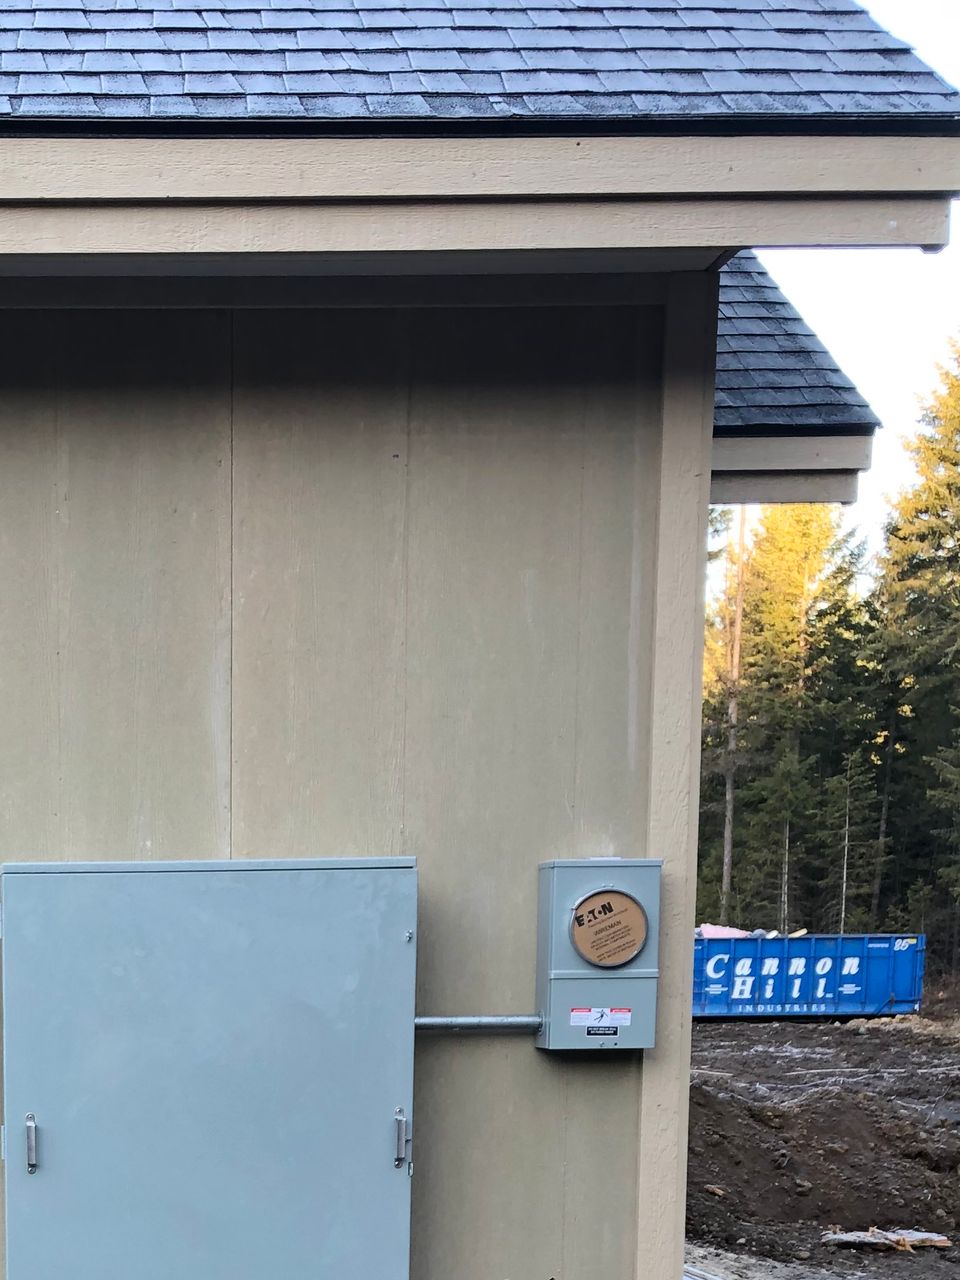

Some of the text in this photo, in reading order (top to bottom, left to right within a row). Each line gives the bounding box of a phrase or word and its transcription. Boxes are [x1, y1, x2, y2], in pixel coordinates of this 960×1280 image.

[706, 953, 860, 979] Cannon
[731, 976, 827, 999] Hill
[739, 1003, 826, 1013] INDUSTRIES
